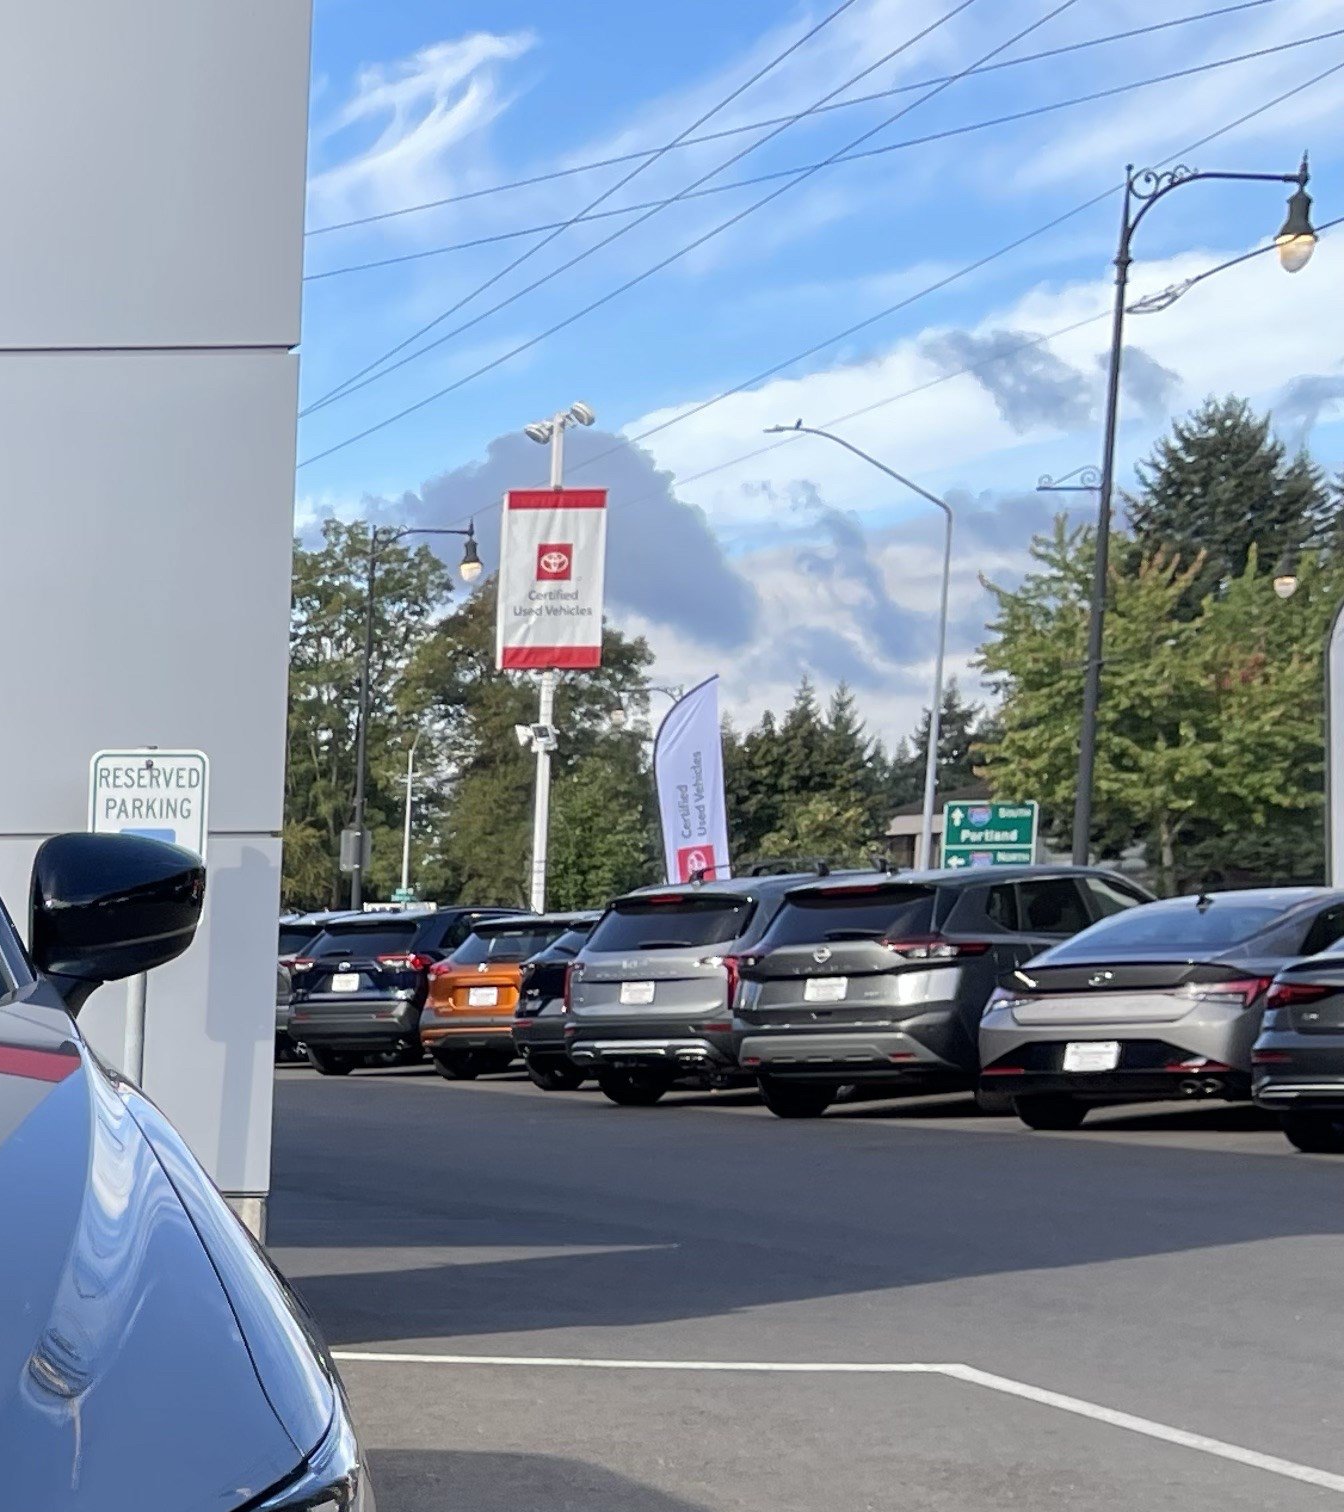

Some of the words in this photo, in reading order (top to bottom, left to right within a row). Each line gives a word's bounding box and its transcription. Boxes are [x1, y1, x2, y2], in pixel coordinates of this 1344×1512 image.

[527, 589, 579, 601] Certified
[513, 604, 543, 617] Used
[545, 604, 593, 617] Vehicles
[98, 767, 201, 789] RESERVED
[690, 751, 705, 803] Vehicles
[105, 798, 192, 820] PARKING
[676, 784, 692, 839] Certified
[695, 804, 708, 836] Used
[960, 828, 1019, 843] Portland
